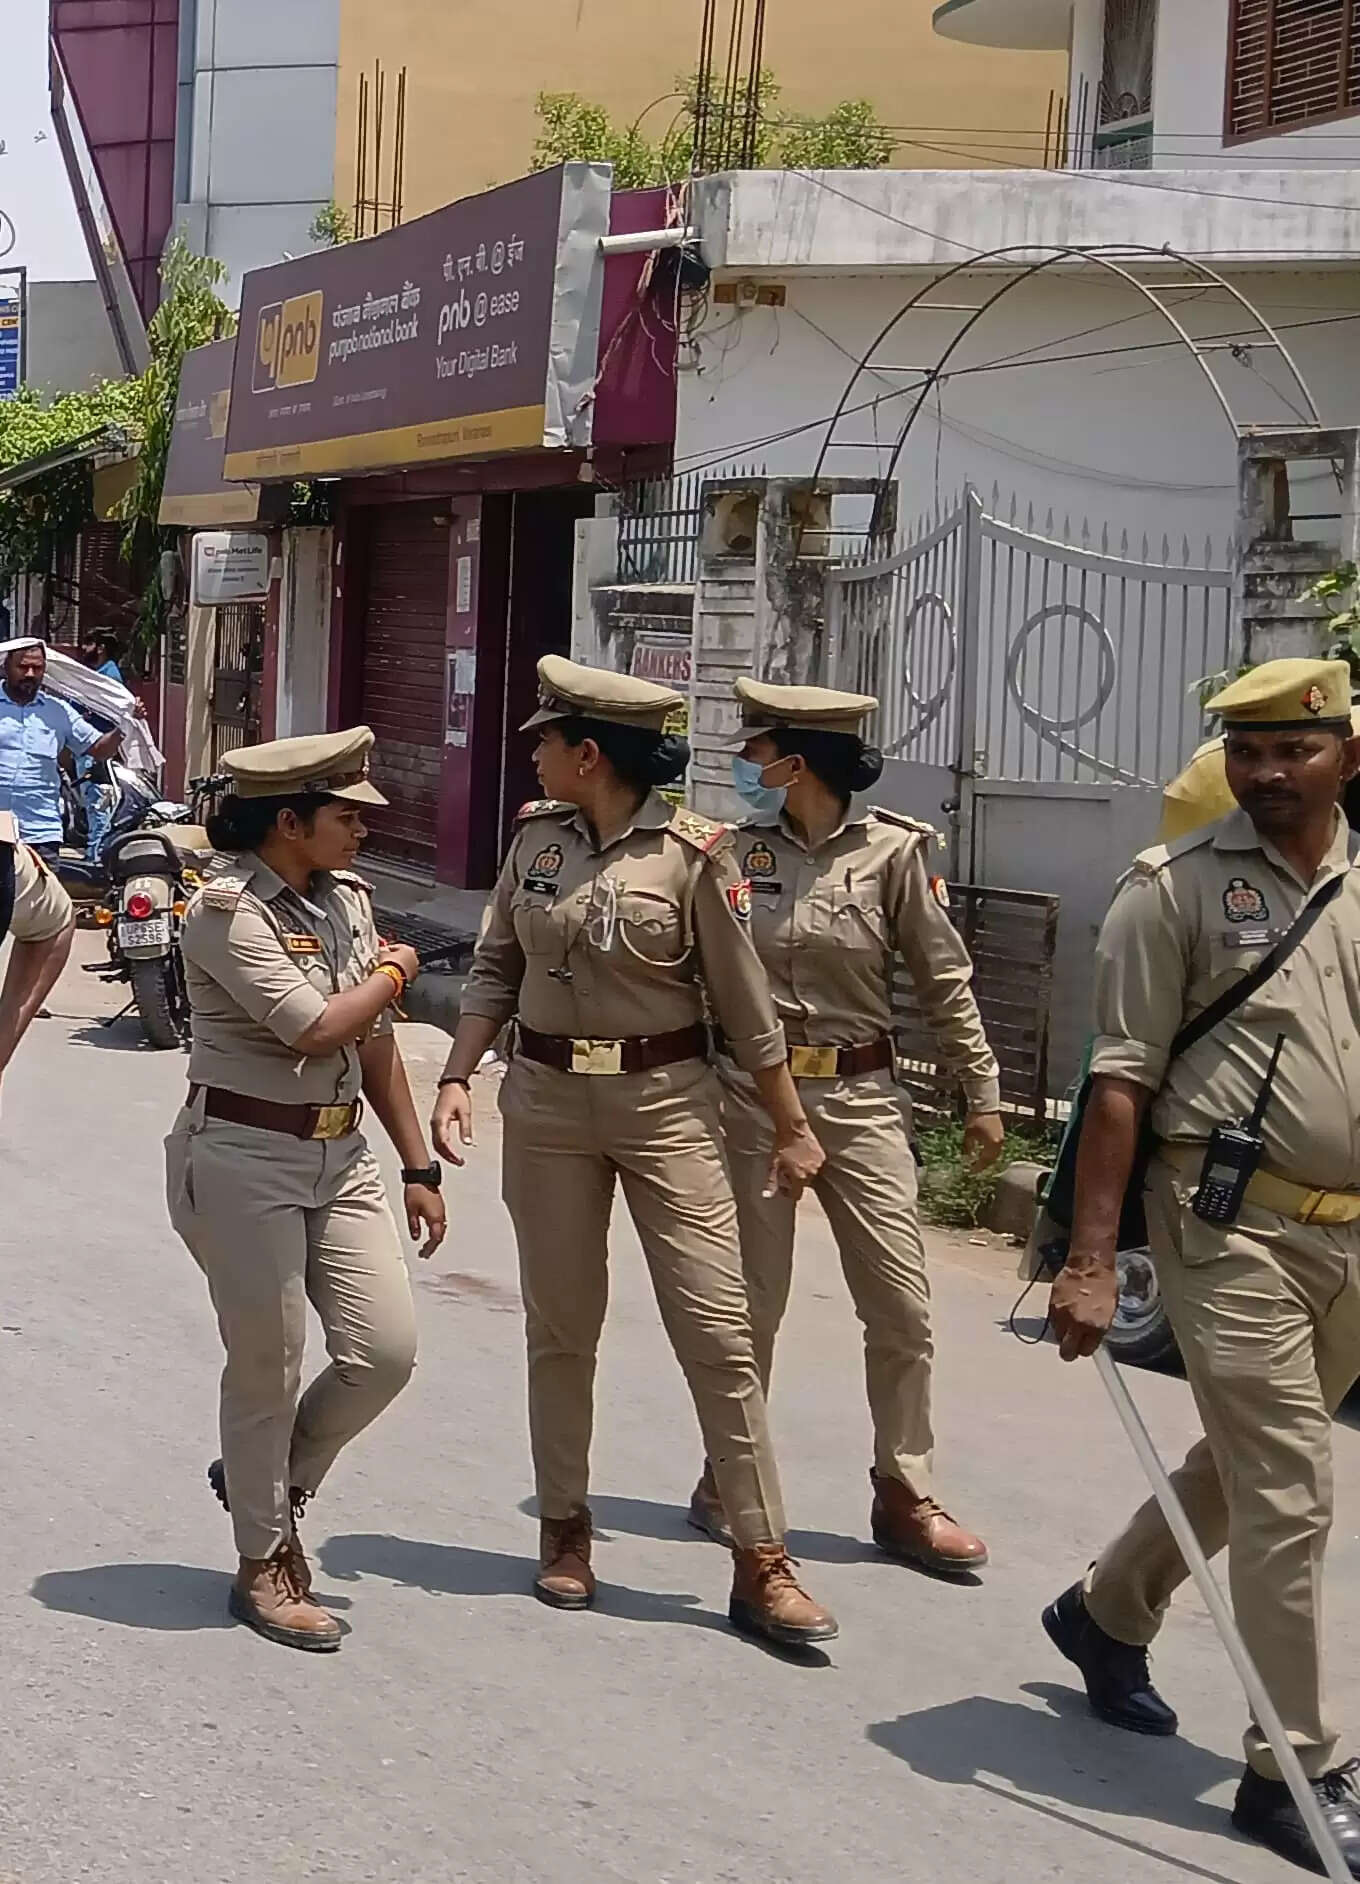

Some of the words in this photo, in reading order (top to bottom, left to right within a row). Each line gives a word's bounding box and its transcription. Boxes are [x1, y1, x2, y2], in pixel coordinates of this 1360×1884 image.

[280, 304, 317, 375] pnb
[395, 313, 419, 344] bank
[438, 289, 471, 345] pnb
[490, 290, 520, 316] ease
[436, 357, 458, 379] Your
[458, 346, 488, 379] Digital
[491, 341, 519, 369] Bank
